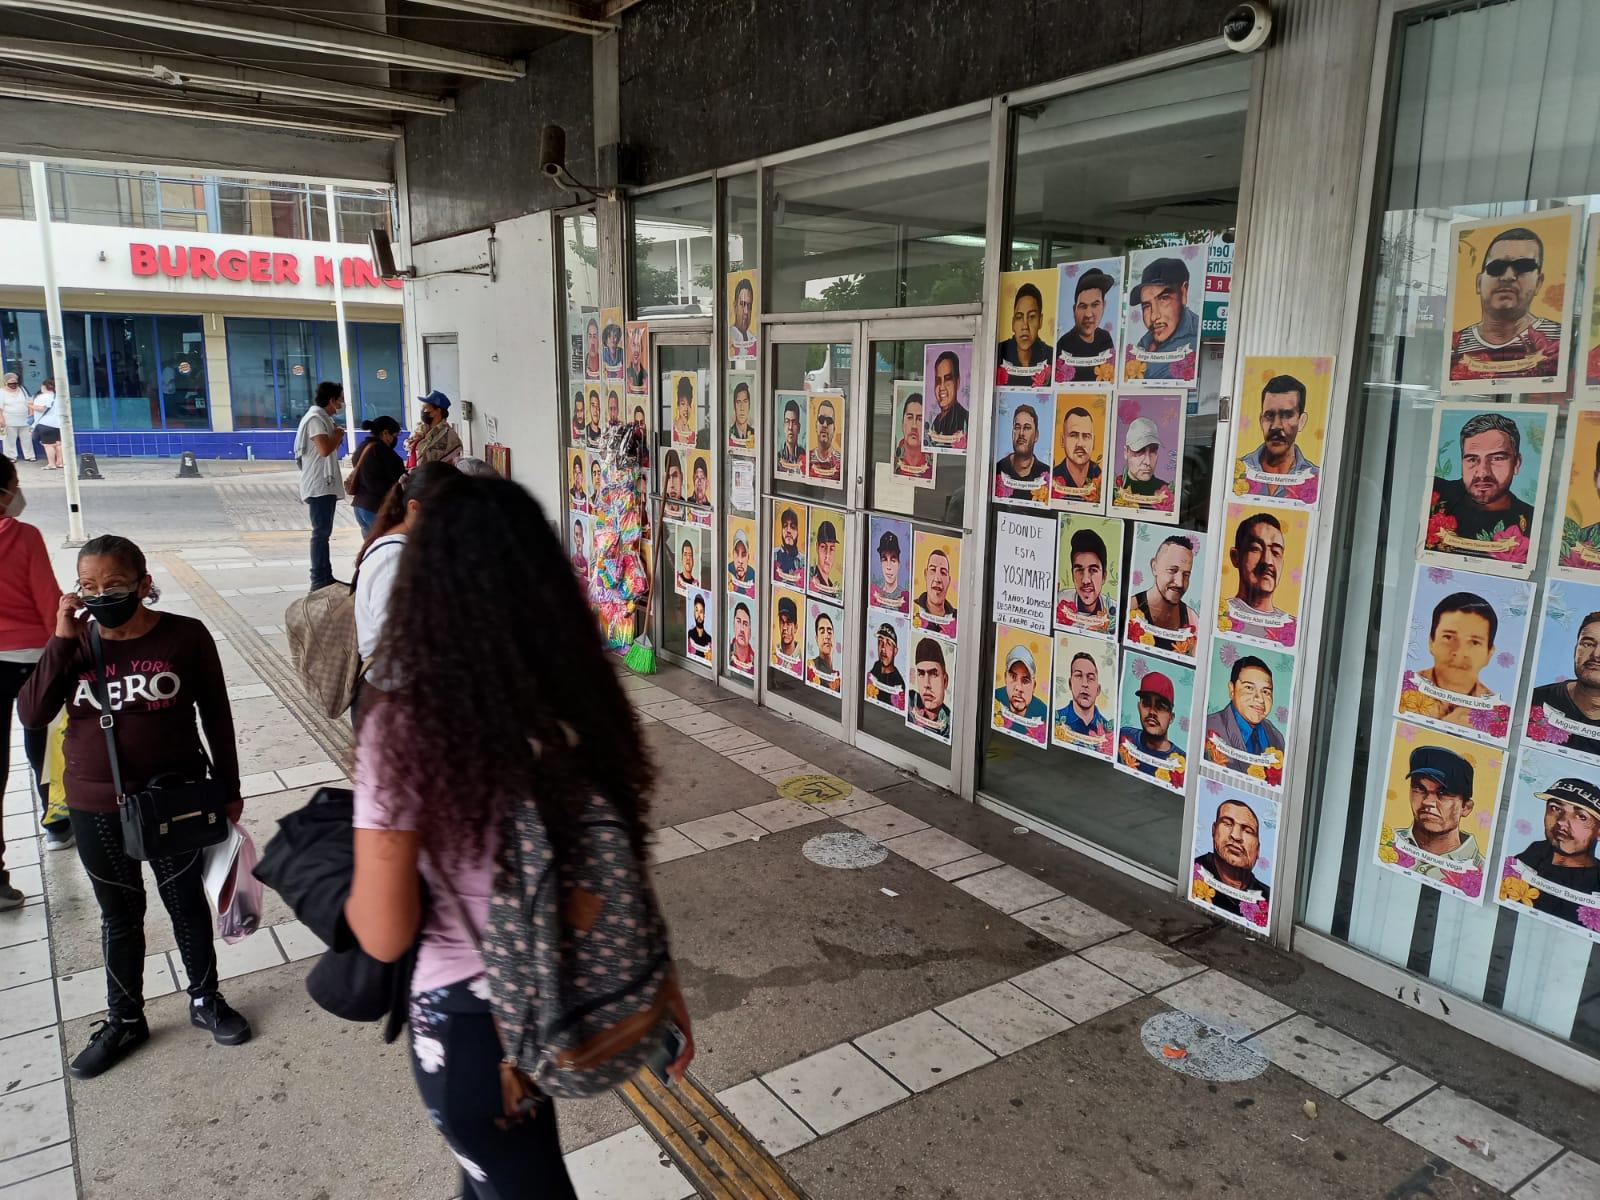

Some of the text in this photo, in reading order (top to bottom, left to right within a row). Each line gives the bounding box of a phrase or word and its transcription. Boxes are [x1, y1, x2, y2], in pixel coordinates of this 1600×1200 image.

[129, 243, 404, 289] BURGER KIN
[73, 672, 180, 711] AERO
[1424, 686, 1447, 699] Ricardo
[1474, 700, 1492, 709] Uribe
[1555, 718, 1580, 730] Miguel
[1422, 852, 1445, 866] Manuel
[1446, 861, 1463, 872] Vega
[1531, 877, 1596, 905] Salvador Bayardo
